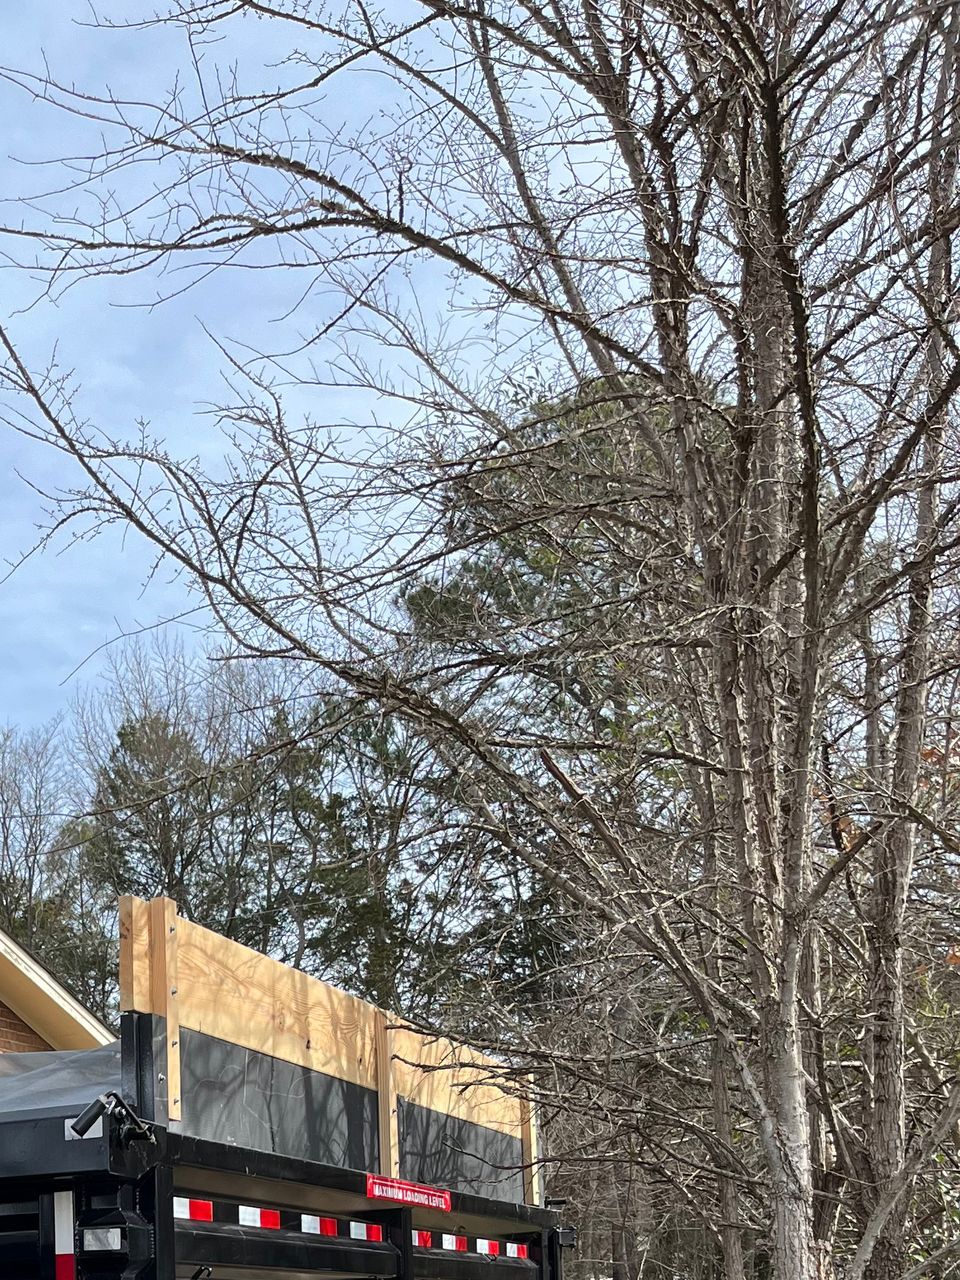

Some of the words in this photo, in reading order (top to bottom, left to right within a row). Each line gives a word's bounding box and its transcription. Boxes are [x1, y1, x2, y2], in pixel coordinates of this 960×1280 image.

[373, 1184, 402, 1200] MAXIMUM
[404, 1190, 428, 1205] LOADING
[429, 1195, 446, 1209] LEVEL
